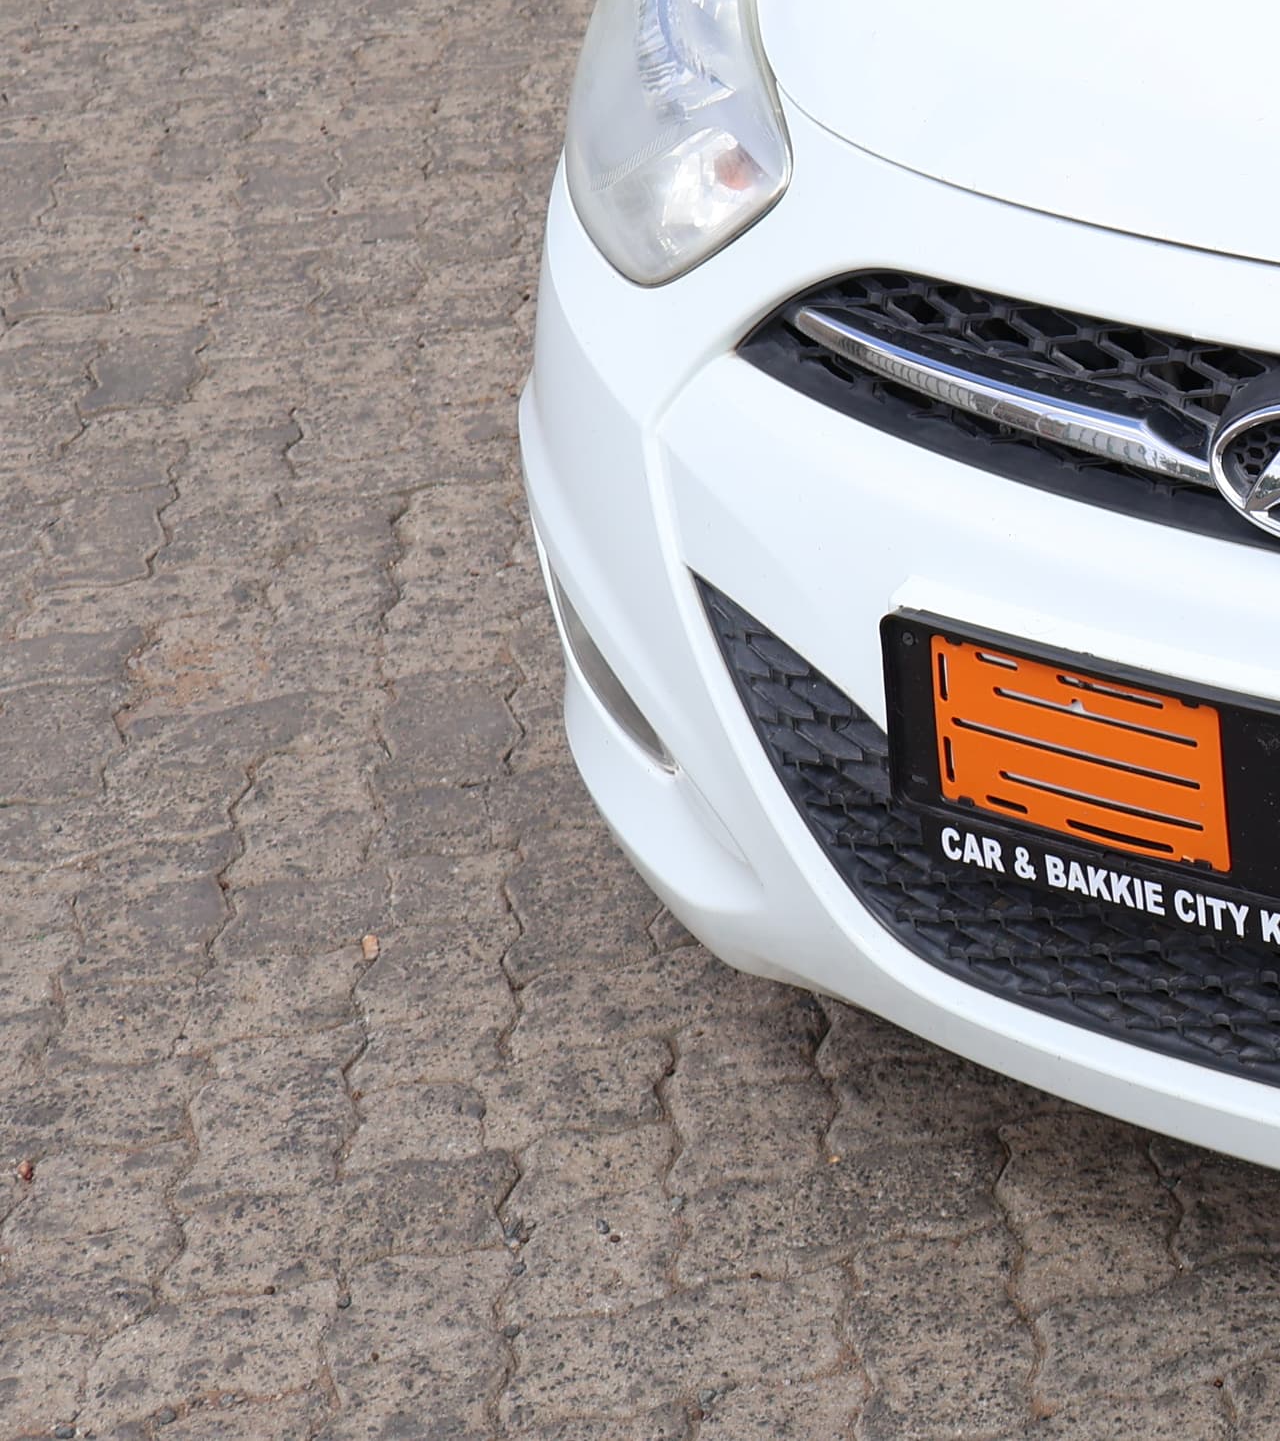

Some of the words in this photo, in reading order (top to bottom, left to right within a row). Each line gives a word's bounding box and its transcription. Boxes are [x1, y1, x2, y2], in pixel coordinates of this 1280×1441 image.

[941, 827, 1005, 873] CAR
[1013, 846, 1038, 881] &
[1044, 853, 1167, 916] BAKKIE
[1174, 889, 1250, 939] CITY
